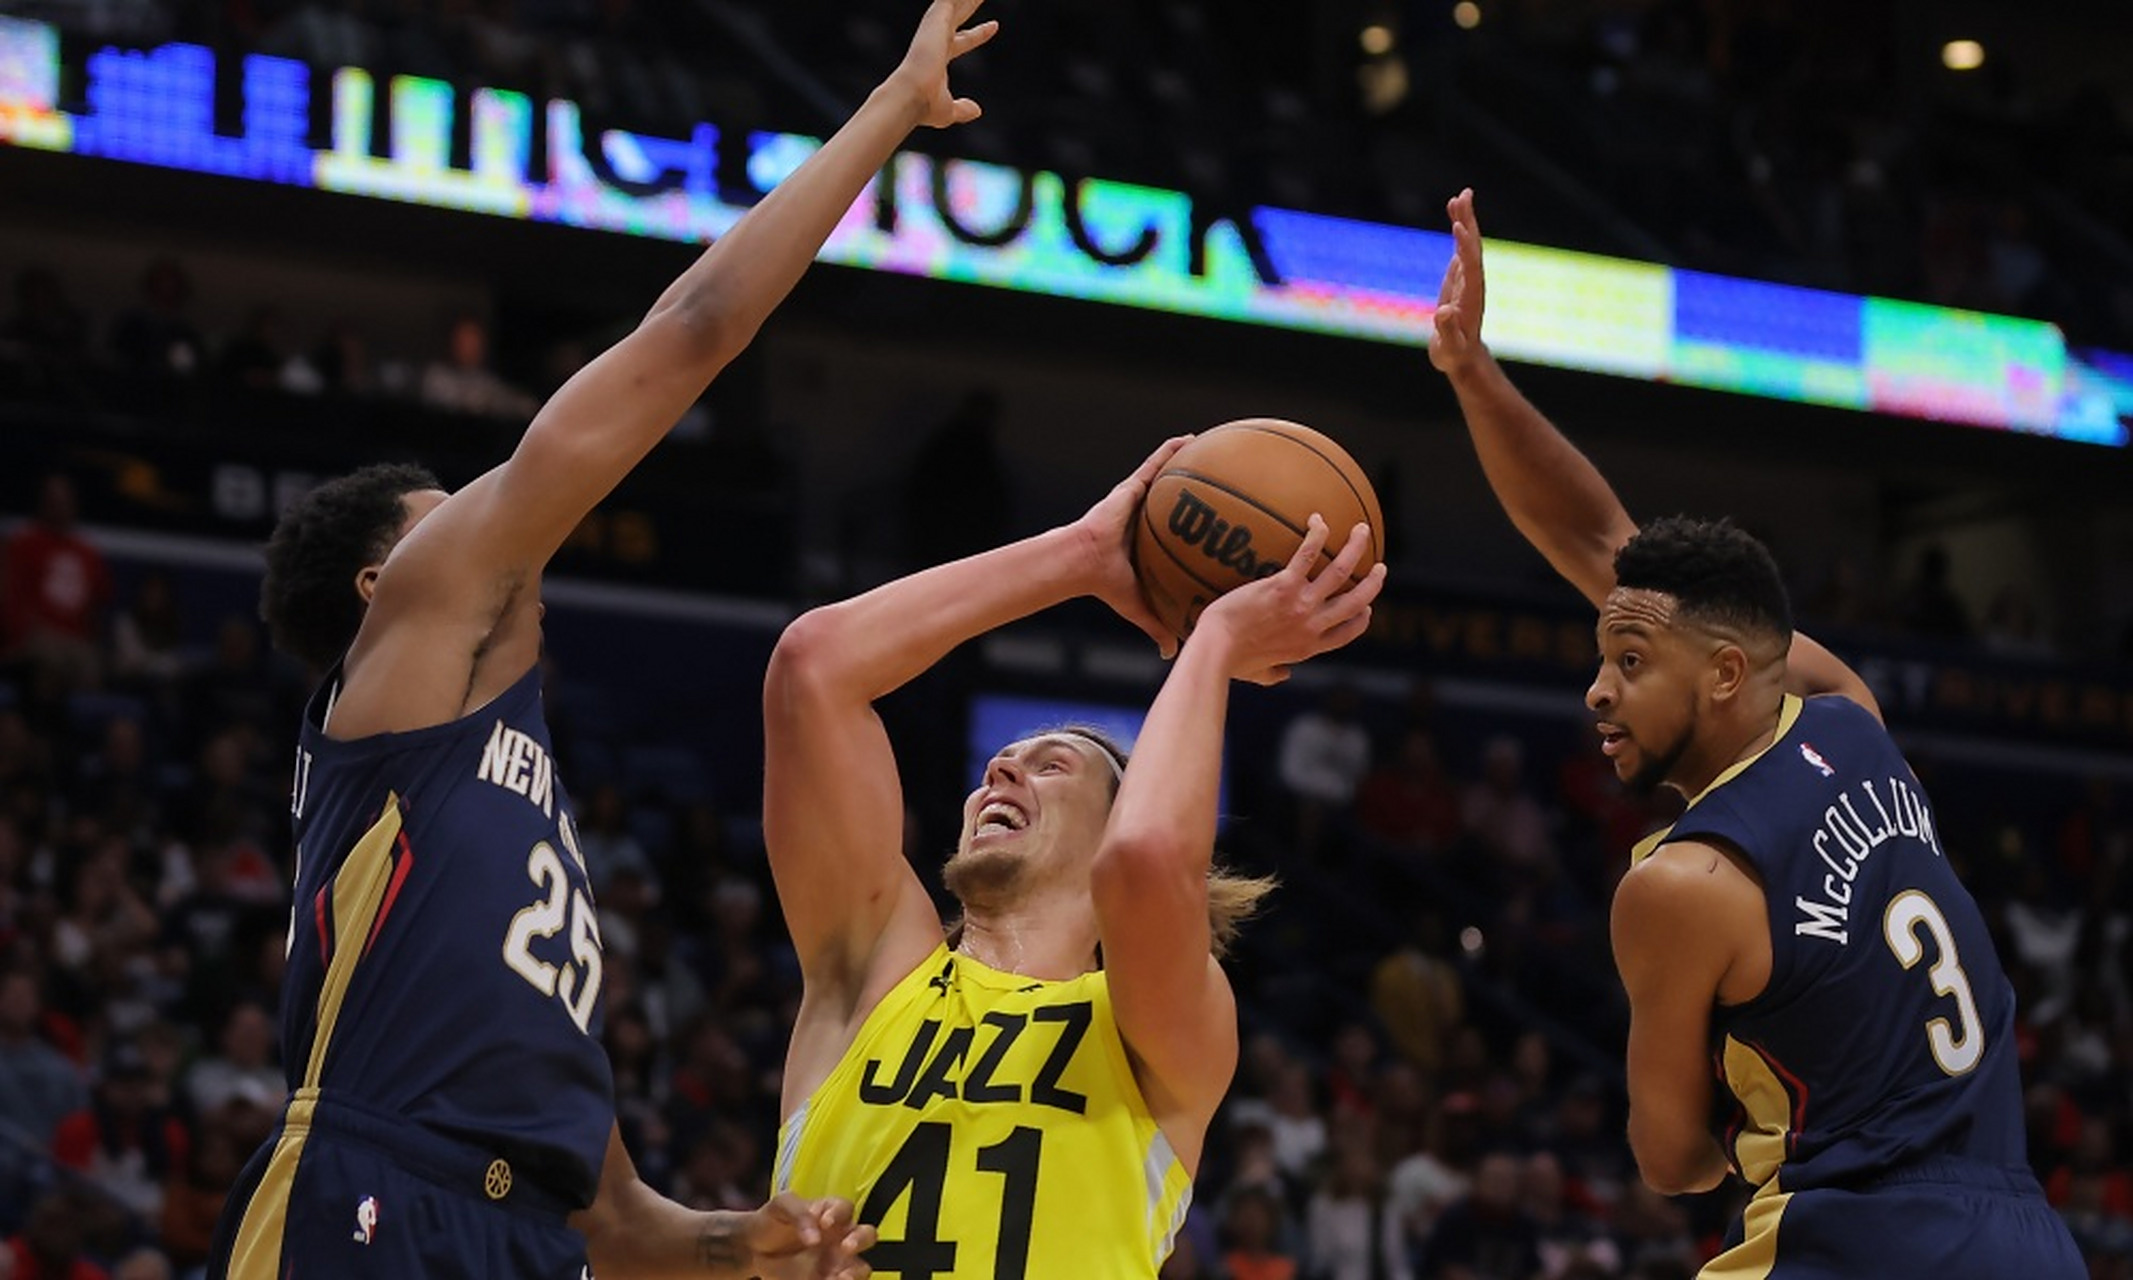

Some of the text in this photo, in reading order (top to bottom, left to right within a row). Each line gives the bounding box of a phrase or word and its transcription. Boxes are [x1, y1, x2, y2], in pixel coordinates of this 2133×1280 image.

[1168, 487, 1283, 577] Wilso
[502, 840, 602, 1036] 25
[1795, 777, 1939, 945] McCOLLUM
[859, 1001, 1093, 1116] JAZZ
[1883, 889, 1984, 1076] 3
[857, 1121, 1043, 1280] 41
